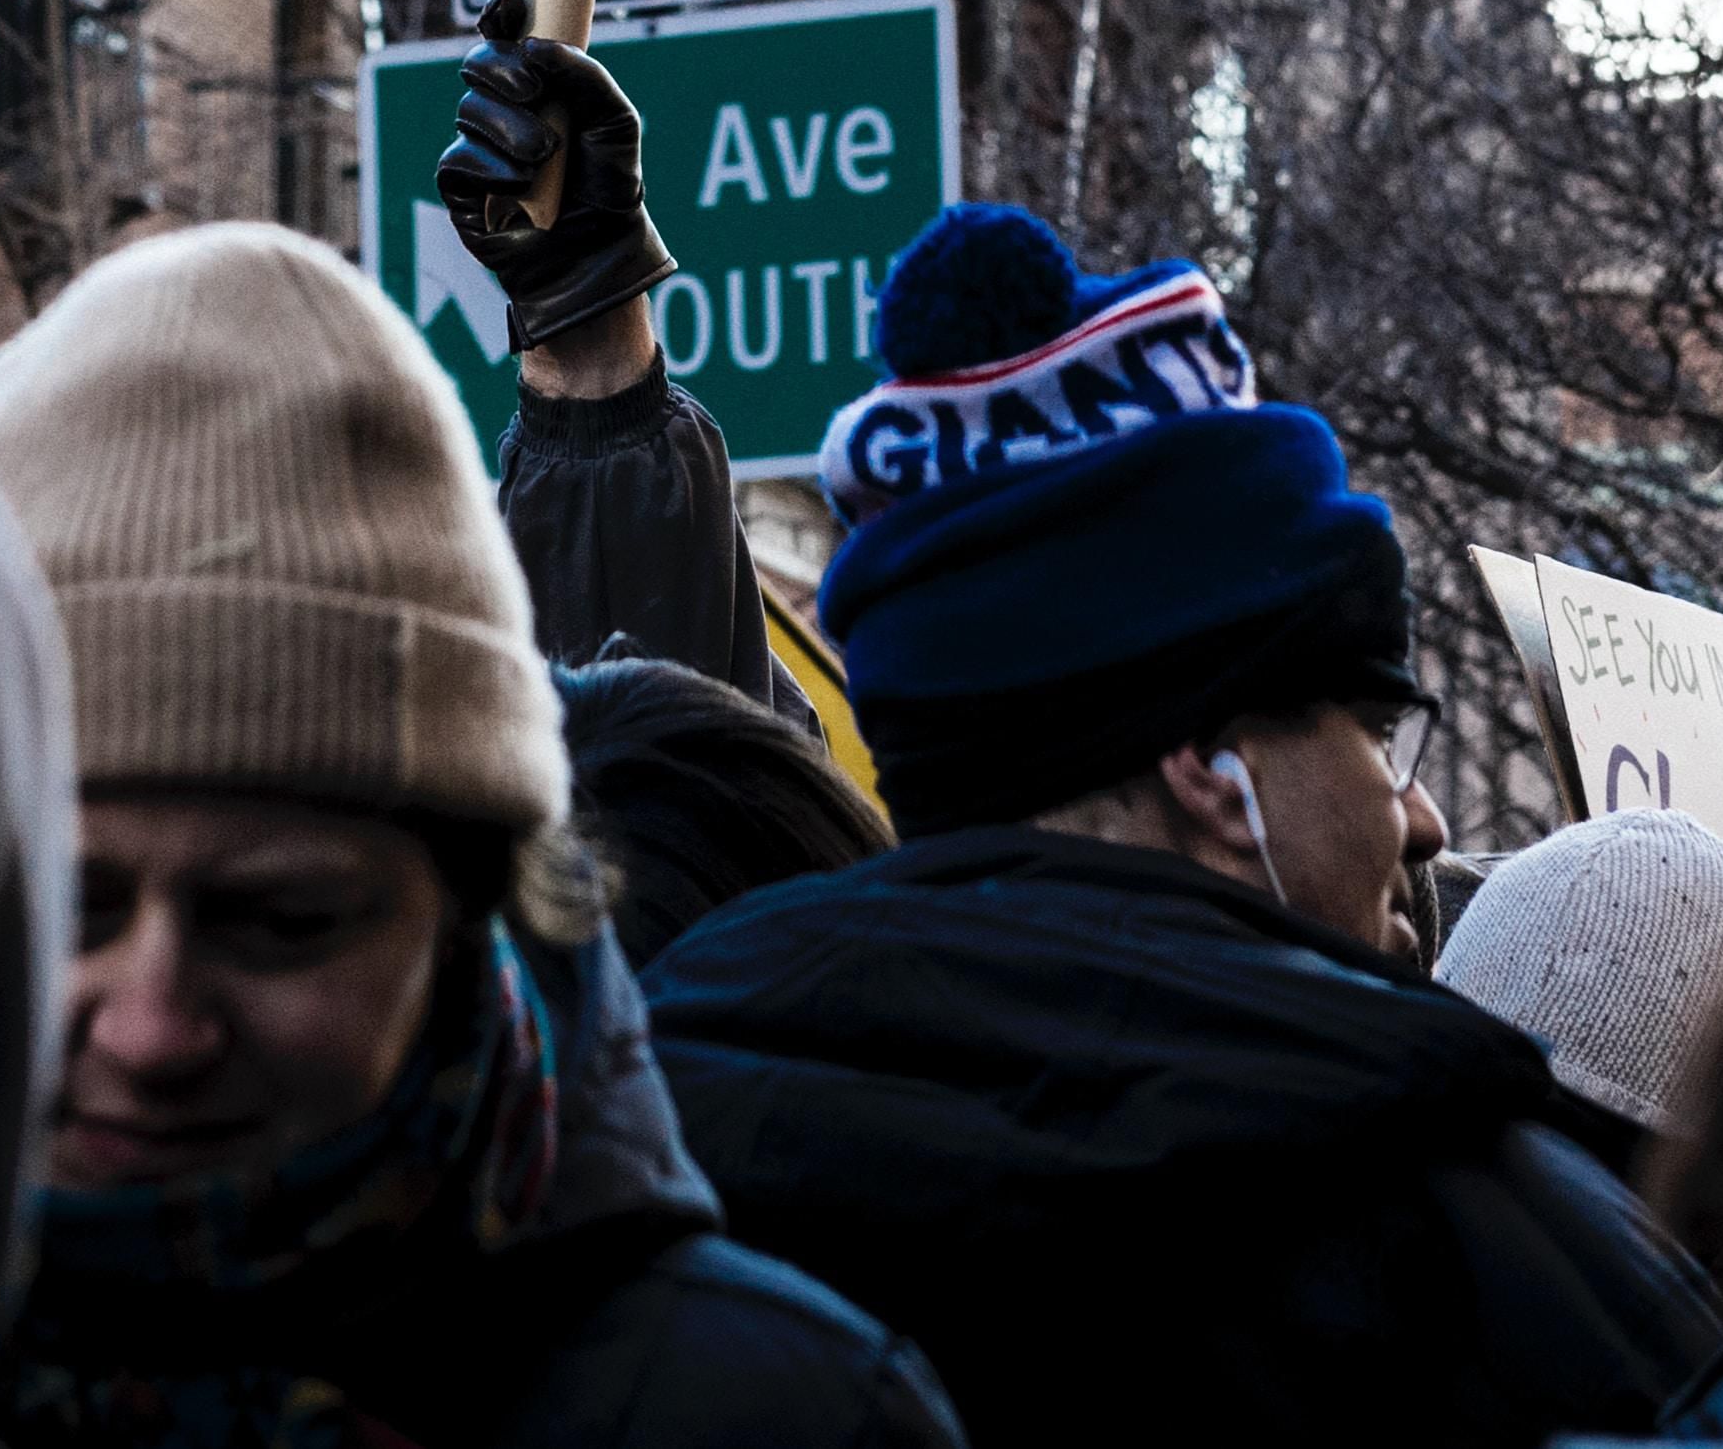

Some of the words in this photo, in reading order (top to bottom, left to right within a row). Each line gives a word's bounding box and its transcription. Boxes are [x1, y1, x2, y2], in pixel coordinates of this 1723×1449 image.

[697, 102, 896, 208] Ave
[651, 256, 895, 377] OUTH
[1561, 594, 1635, 687] SEE
[1633, 617, 1704, 701] YOU
